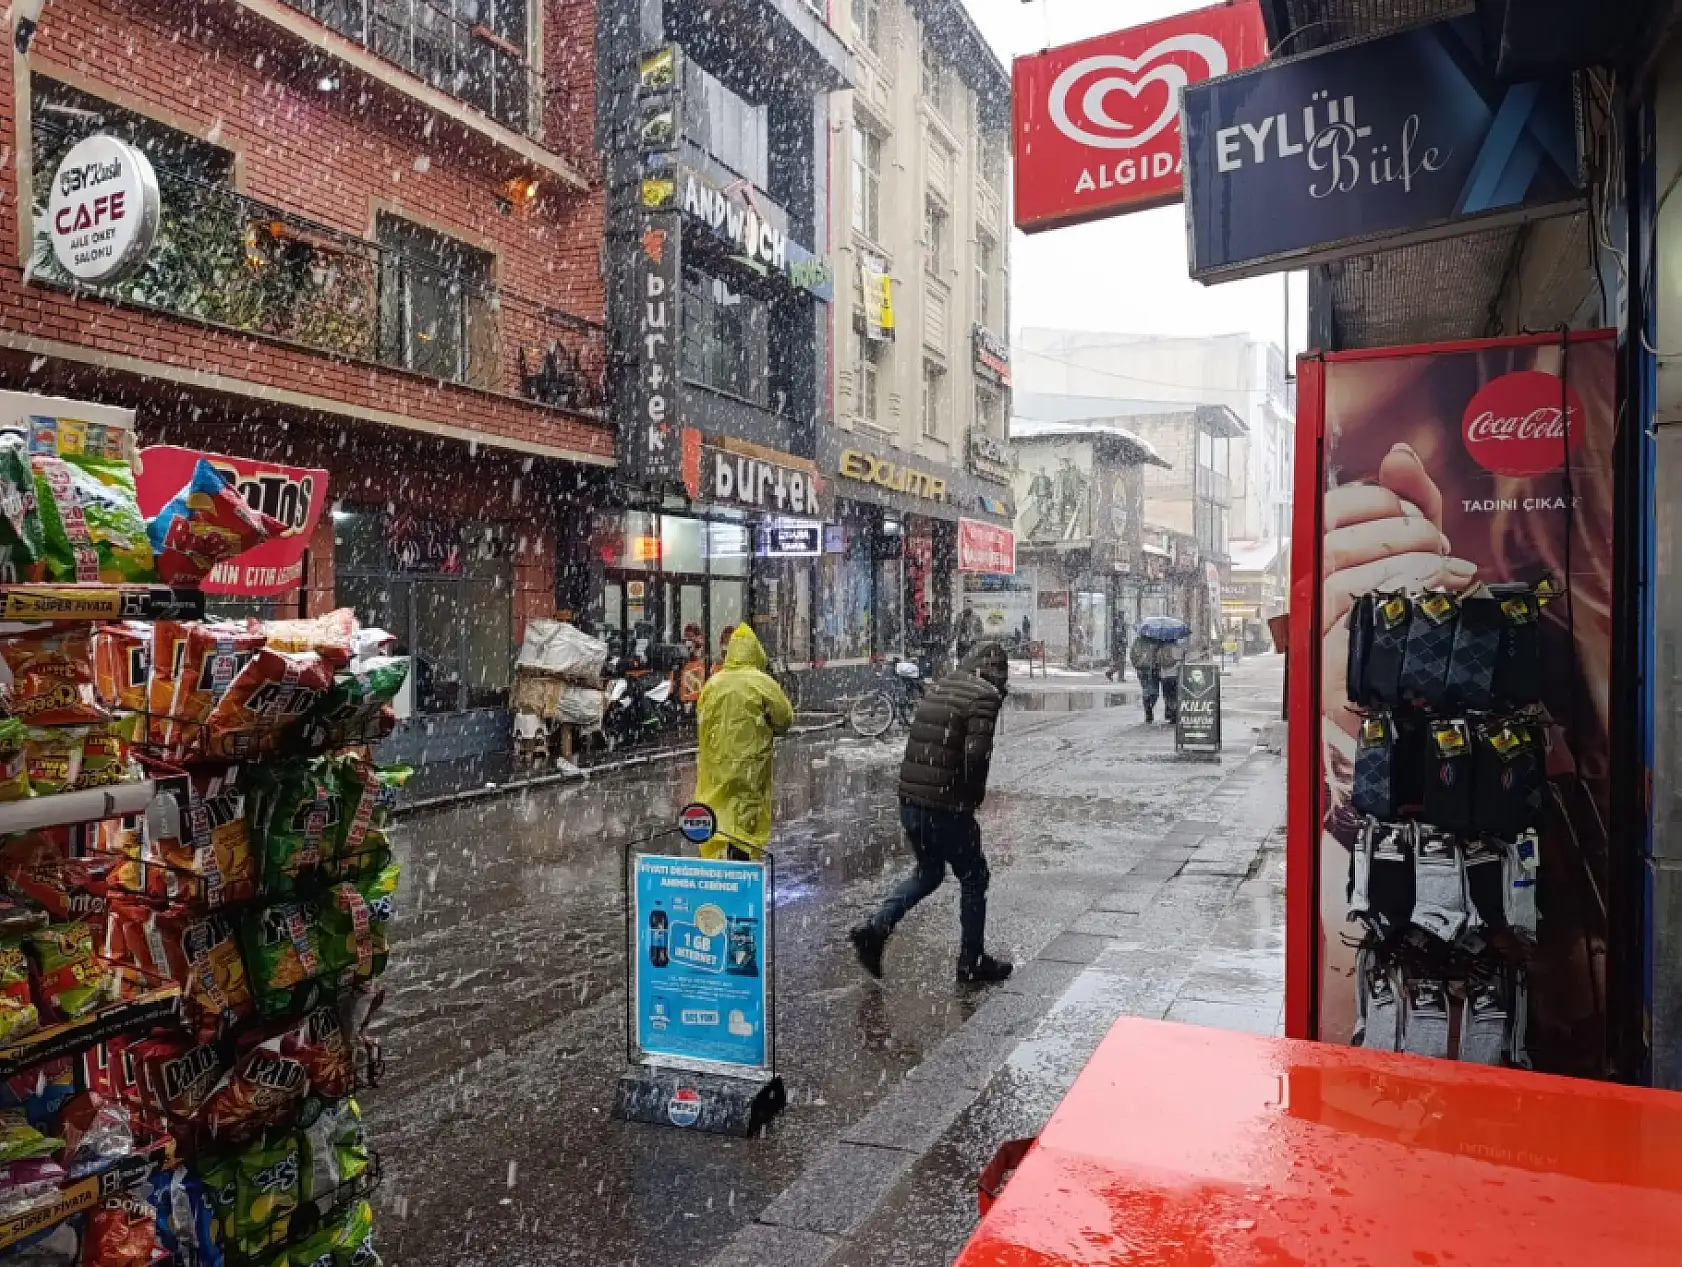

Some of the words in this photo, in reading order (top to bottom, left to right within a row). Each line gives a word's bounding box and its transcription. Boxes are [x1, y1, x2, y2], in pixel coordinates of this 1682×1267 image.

[1308, 114, 1453, 198] Büfe
[55, 190, 125, 235] CAFE
[646, 273, 666, 451] burtek
[715, 453, 821, 515] burtek
[1462, 500, 1517, 513] TADINI
[683, 932, 692, 948] 1
